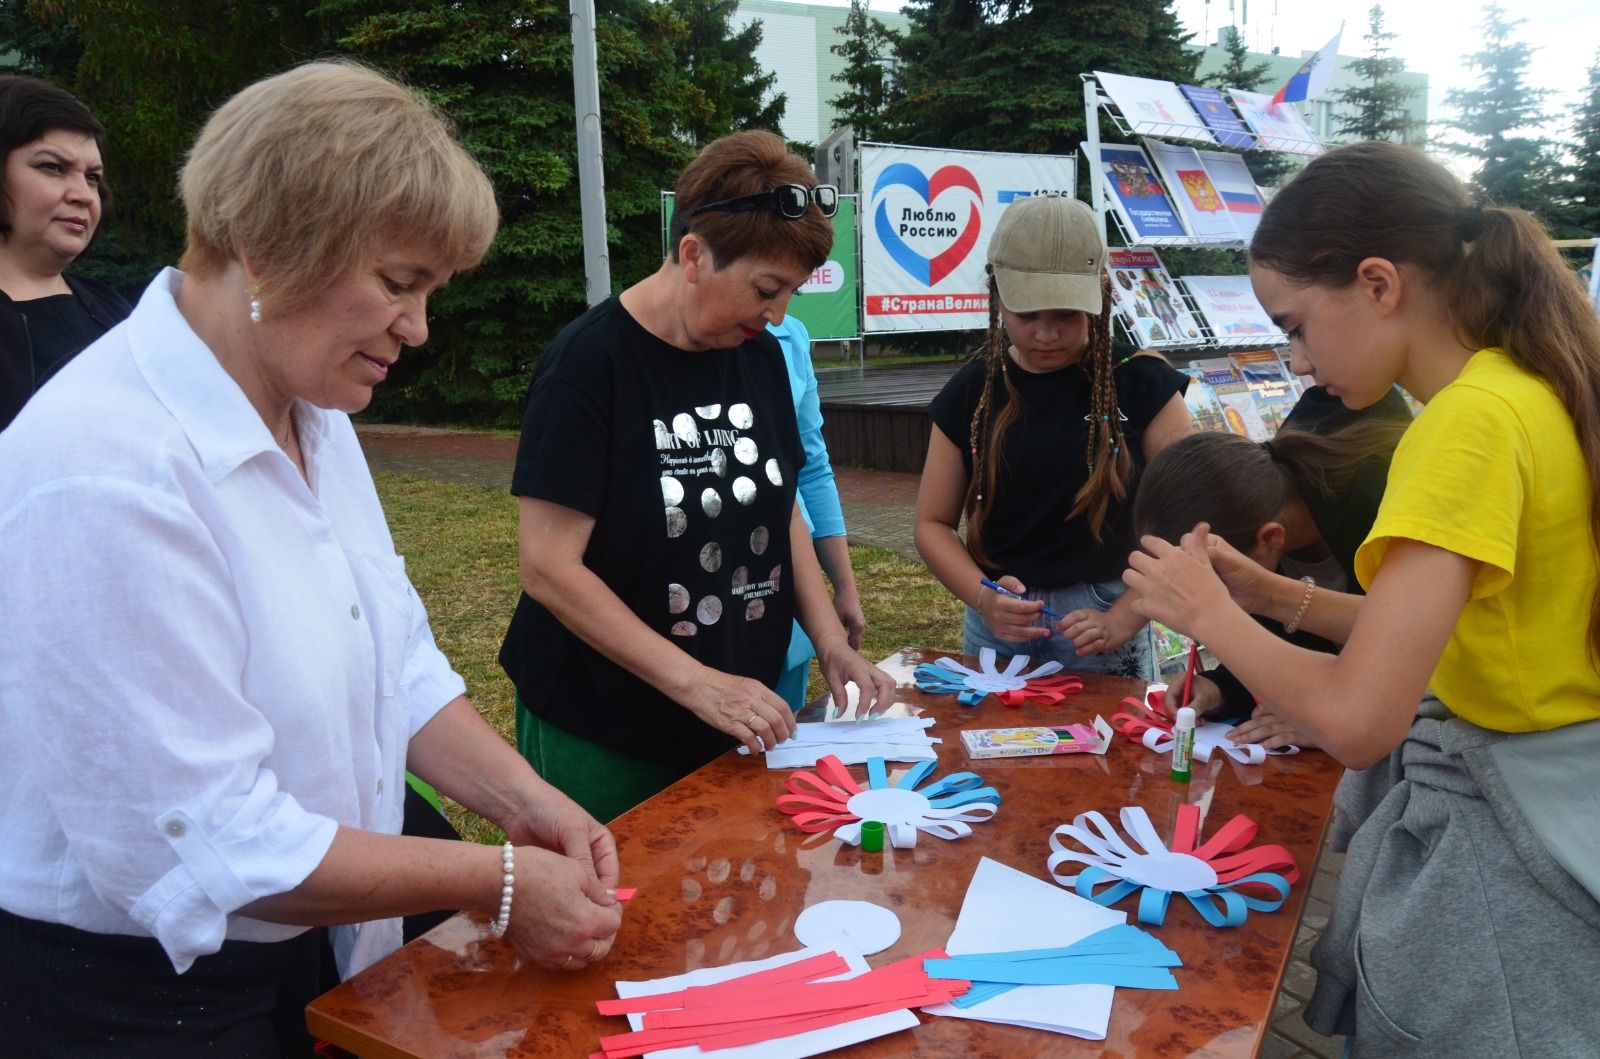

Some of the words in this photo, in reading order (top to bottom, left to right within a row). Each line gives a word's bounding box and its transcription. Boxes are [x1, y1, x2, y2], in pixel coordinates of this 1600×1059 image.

[902, 208, 956, 221] Люблю
[900, 224, 957, 237] Россию
[806, 269, 832, 285] НЕ
[882, 296, 989, 313] #СтранаВелик
[686, 432, 701, 448] OF
[704, 429, 742, 446] LIVING
